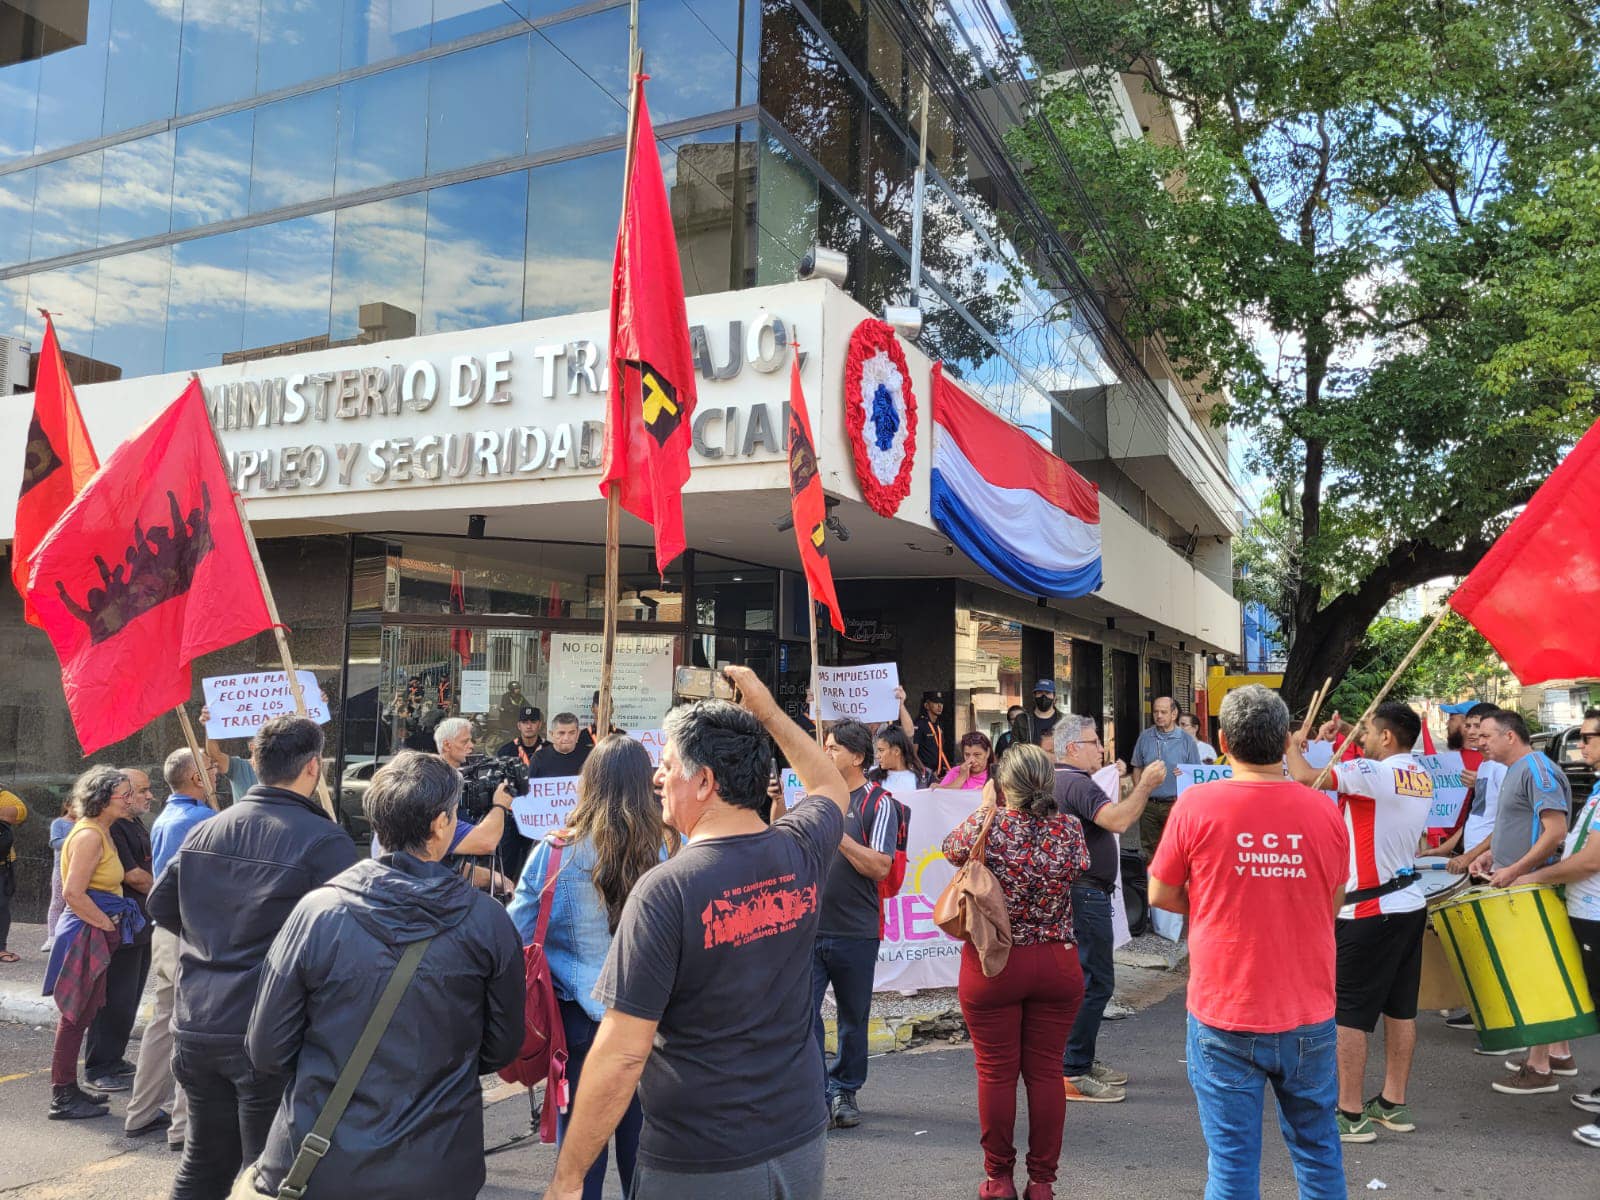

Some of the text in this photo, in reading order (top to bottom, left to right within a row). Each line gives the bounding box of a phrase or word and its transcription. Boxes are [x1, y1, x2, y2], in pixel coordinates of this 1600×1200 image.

[206, 312, 810, 431] MINISTERIO DE TRAJO,
[227, 443, 328, 492] PLEO
[334, 441, 362, 485] Y
[366, 419, 605, 484] SEGURIDAD
[562, 642, 581, 652] NO
[214, 673, 290, 688] POR UN PLA
[832, 668, 888, 682] IMPUESTOS
[822, 686, 869, 698] PARA LOS
[236, 700, 283, 712] DE LOS
[550, 798, 576, 808] UNA
[520, 813, 560, 828] HUELGA
[1238, 852, 1303, 864] UNIDAD
[1234, 865, 1307, 878] Y LUCHA
[888, 950, 904, 962] LA
[906, 945, 962, 961] ESPERAN
